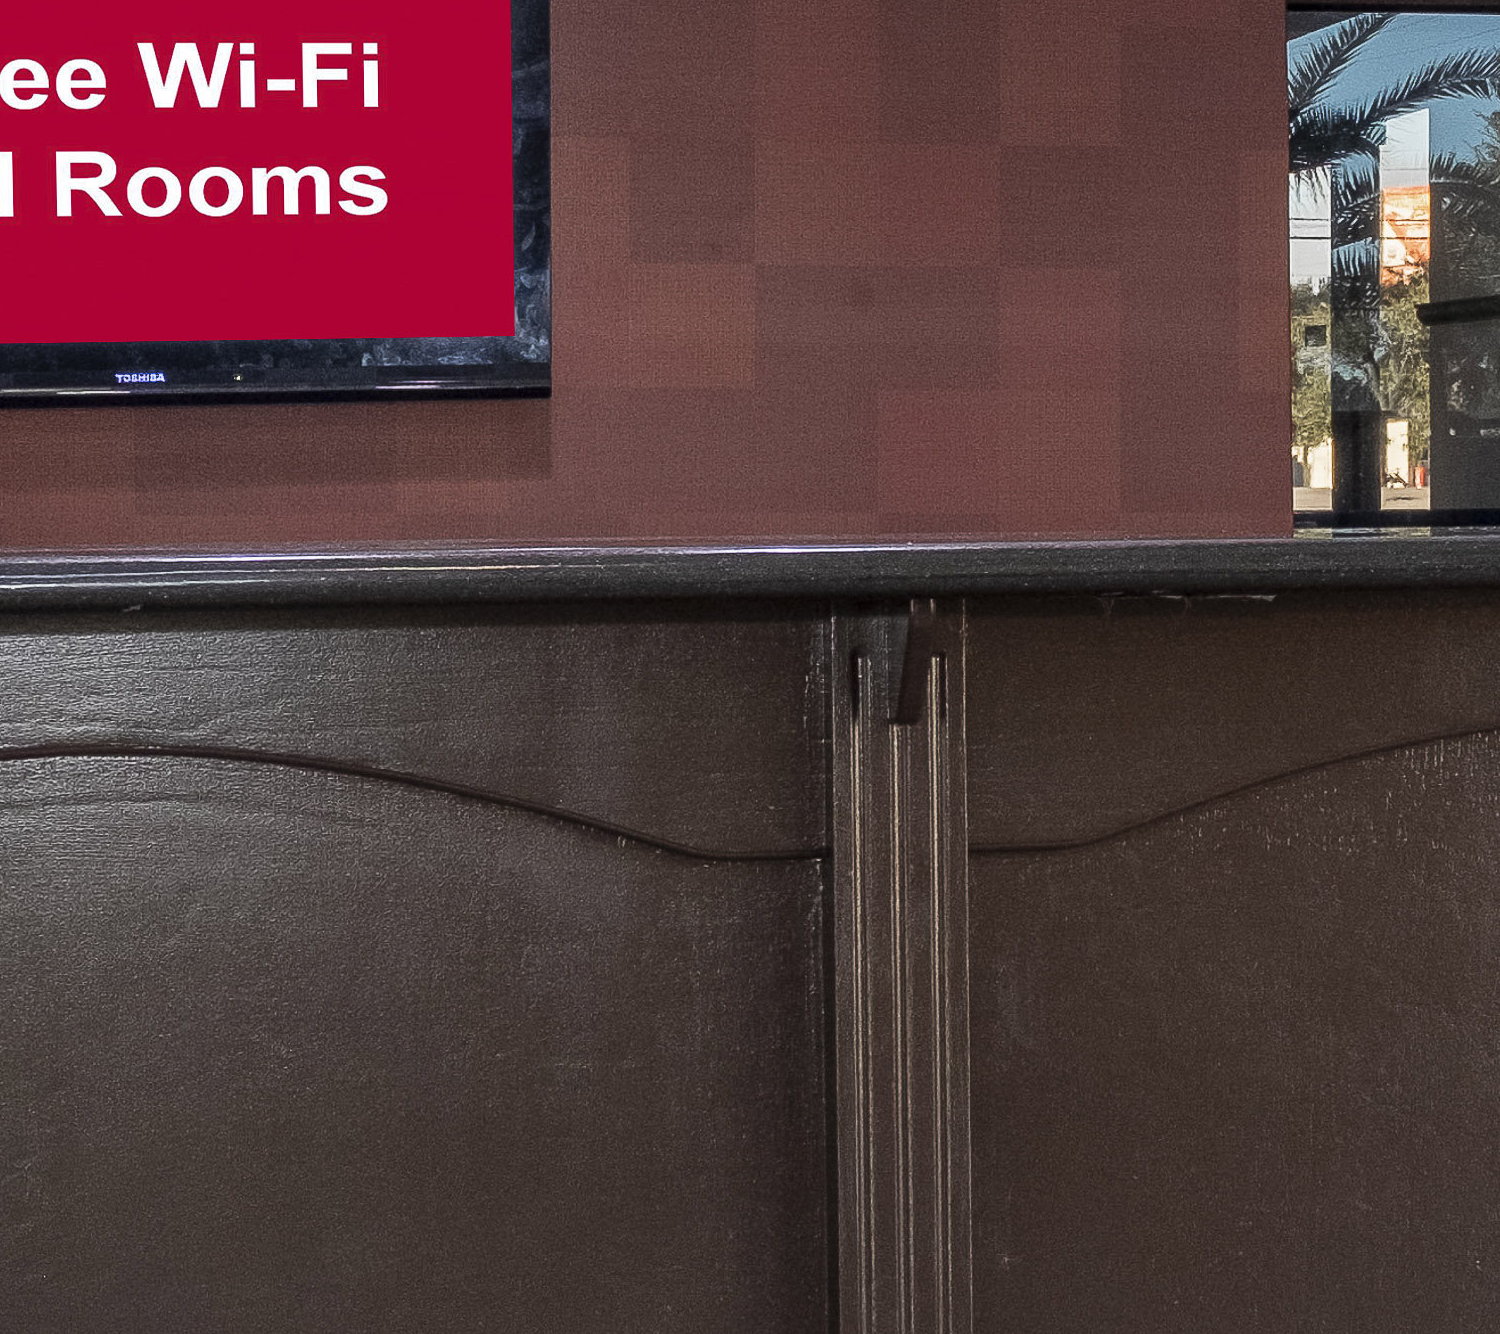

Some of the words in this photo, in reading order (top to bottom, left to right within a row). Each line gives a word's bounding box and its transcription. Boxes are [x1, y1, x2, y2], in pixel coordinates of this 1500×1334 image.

[136, 42, 380, 109] Wi-Fi
[54, 150, 389, 218] Rooms
[114, 372, 166, 383] TOSHIBA
